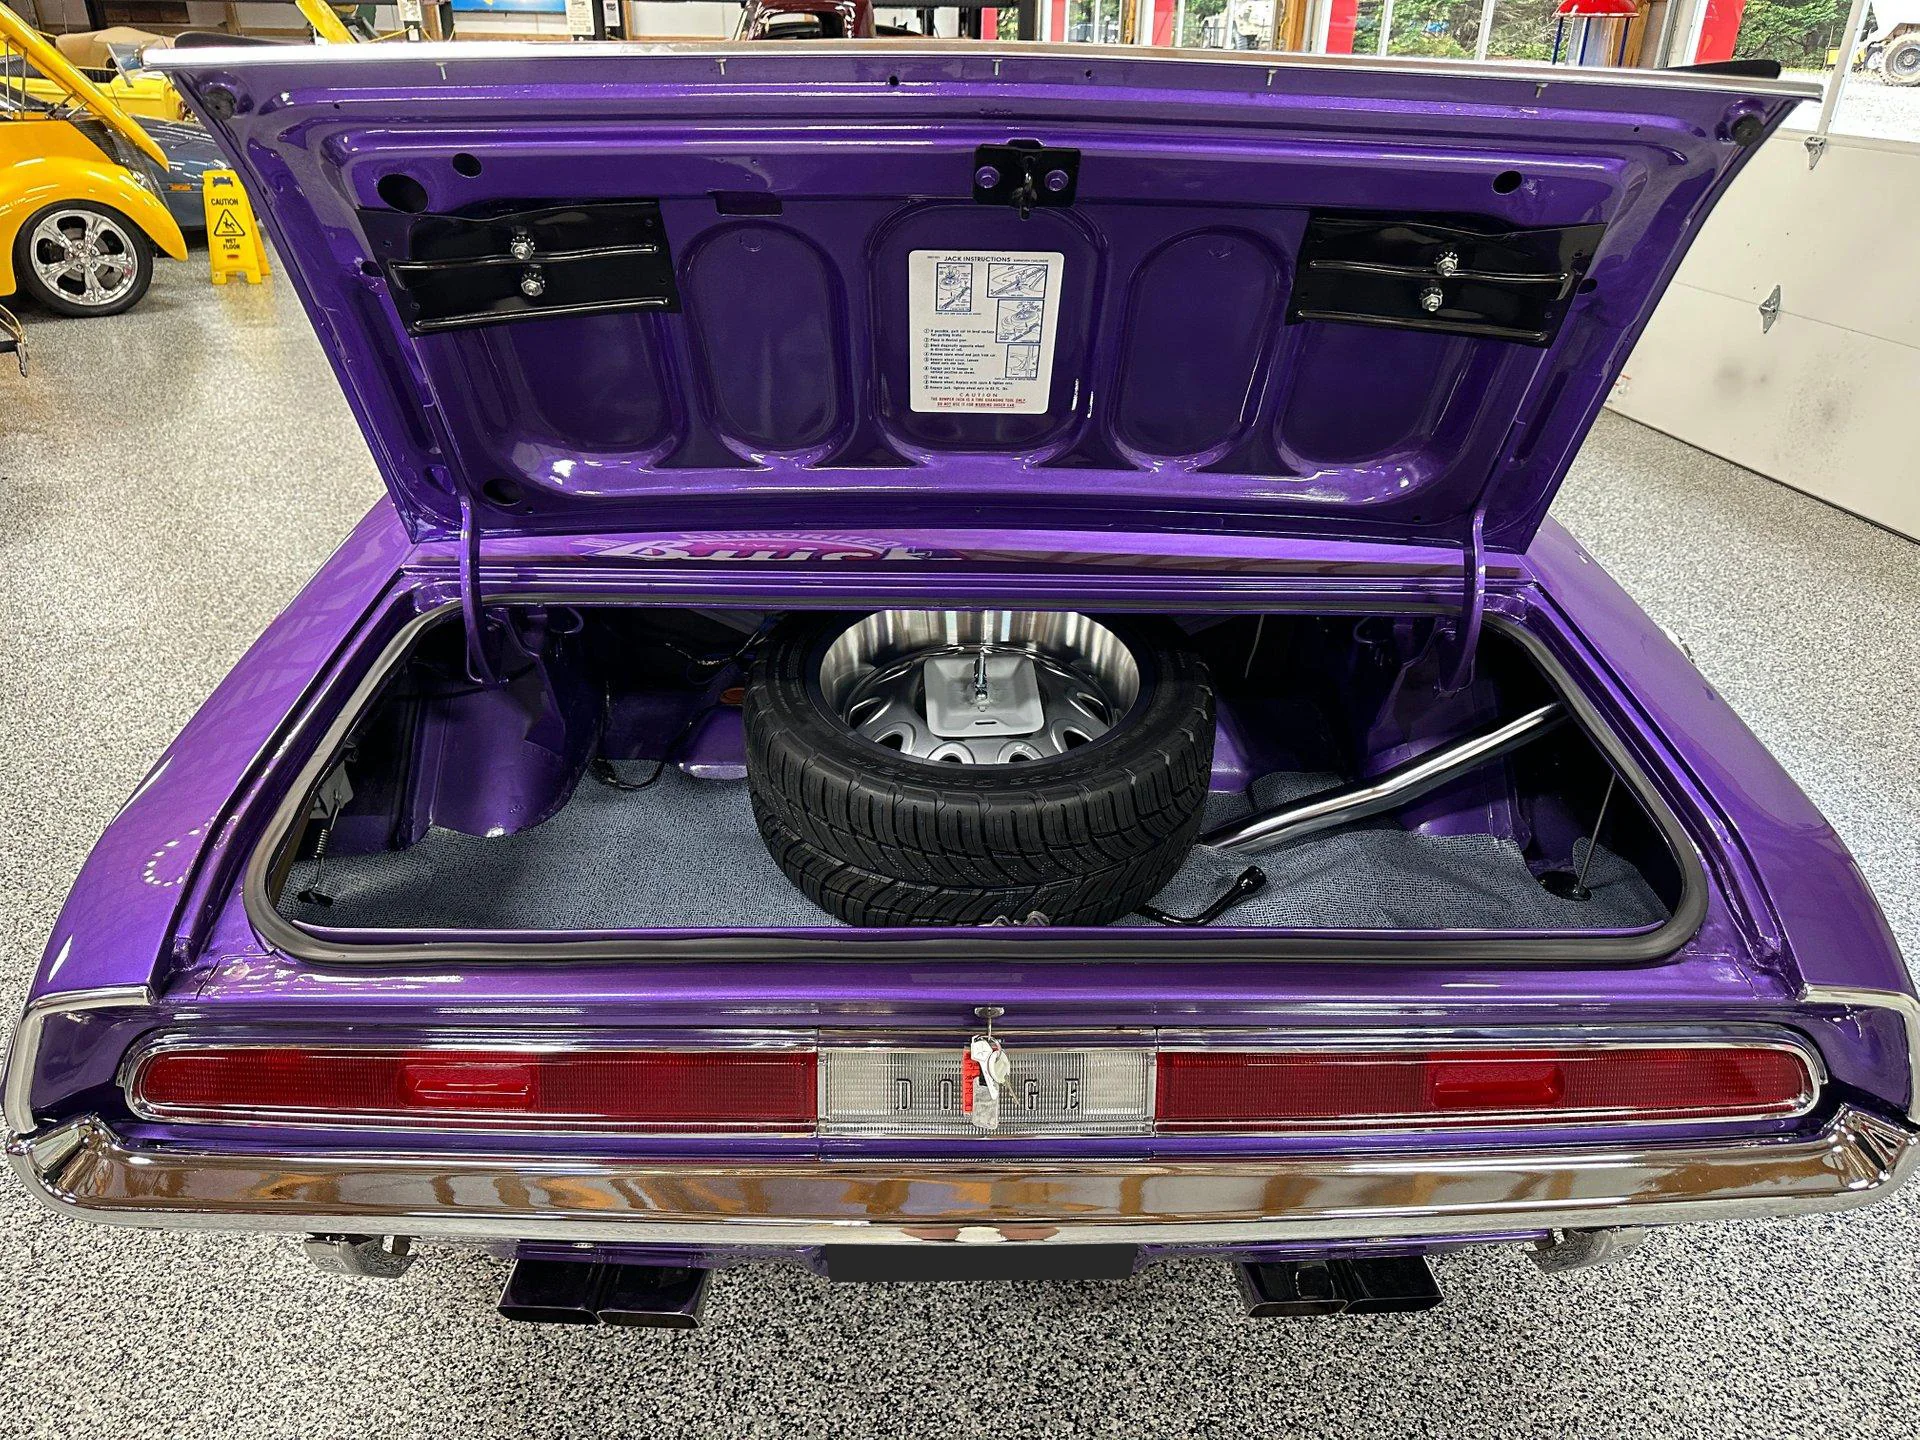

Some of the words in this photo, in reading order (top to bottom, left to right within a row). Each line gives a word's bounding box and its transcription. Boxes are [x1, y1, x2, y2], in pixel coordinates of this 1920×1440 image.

[211, 198, 238, 206] CAUTION
[679, 532, 904, 547] AUTHORIZED
[896, 1078, 1081, 1111] DOGE
